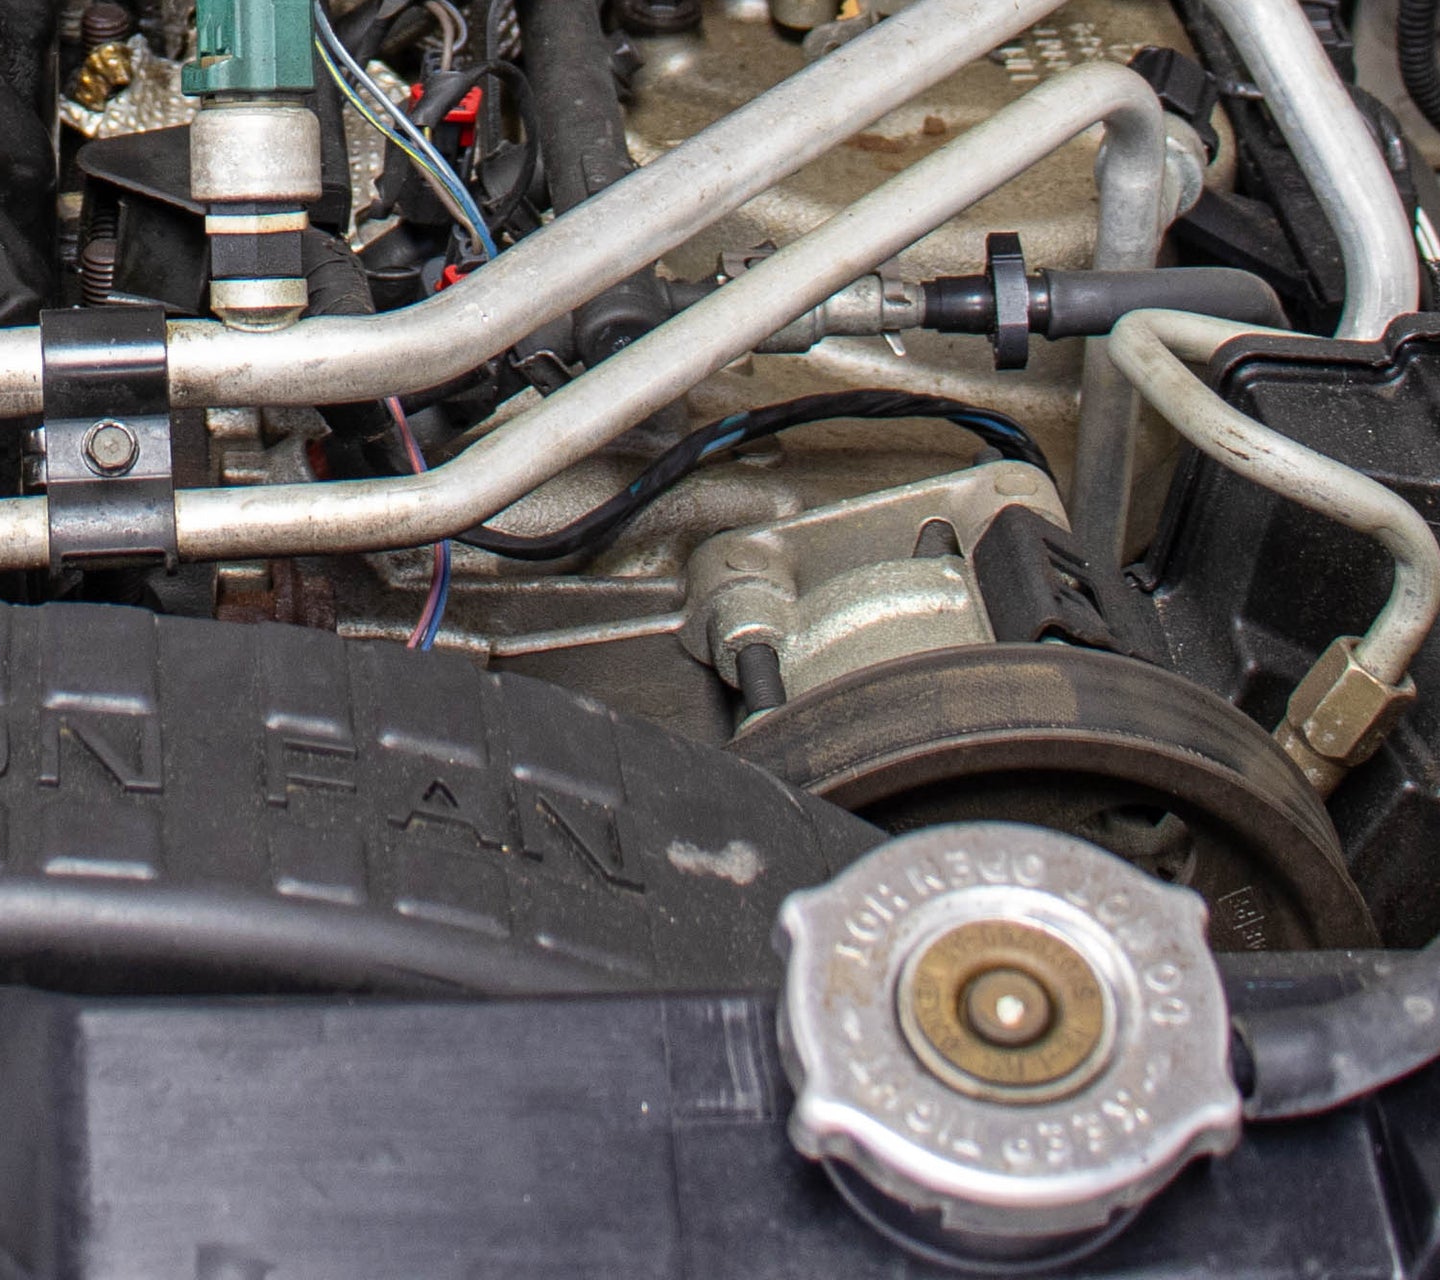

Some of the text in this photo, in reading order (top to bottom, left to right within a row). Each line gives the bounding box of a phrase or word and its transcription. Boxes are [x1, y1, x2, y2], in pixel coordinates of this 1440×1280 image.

[266, 737, 646, 894] FAN
[906, 849, 1045, 897] OPEN
[1001, 1090, 1151, 1166] KEEP
